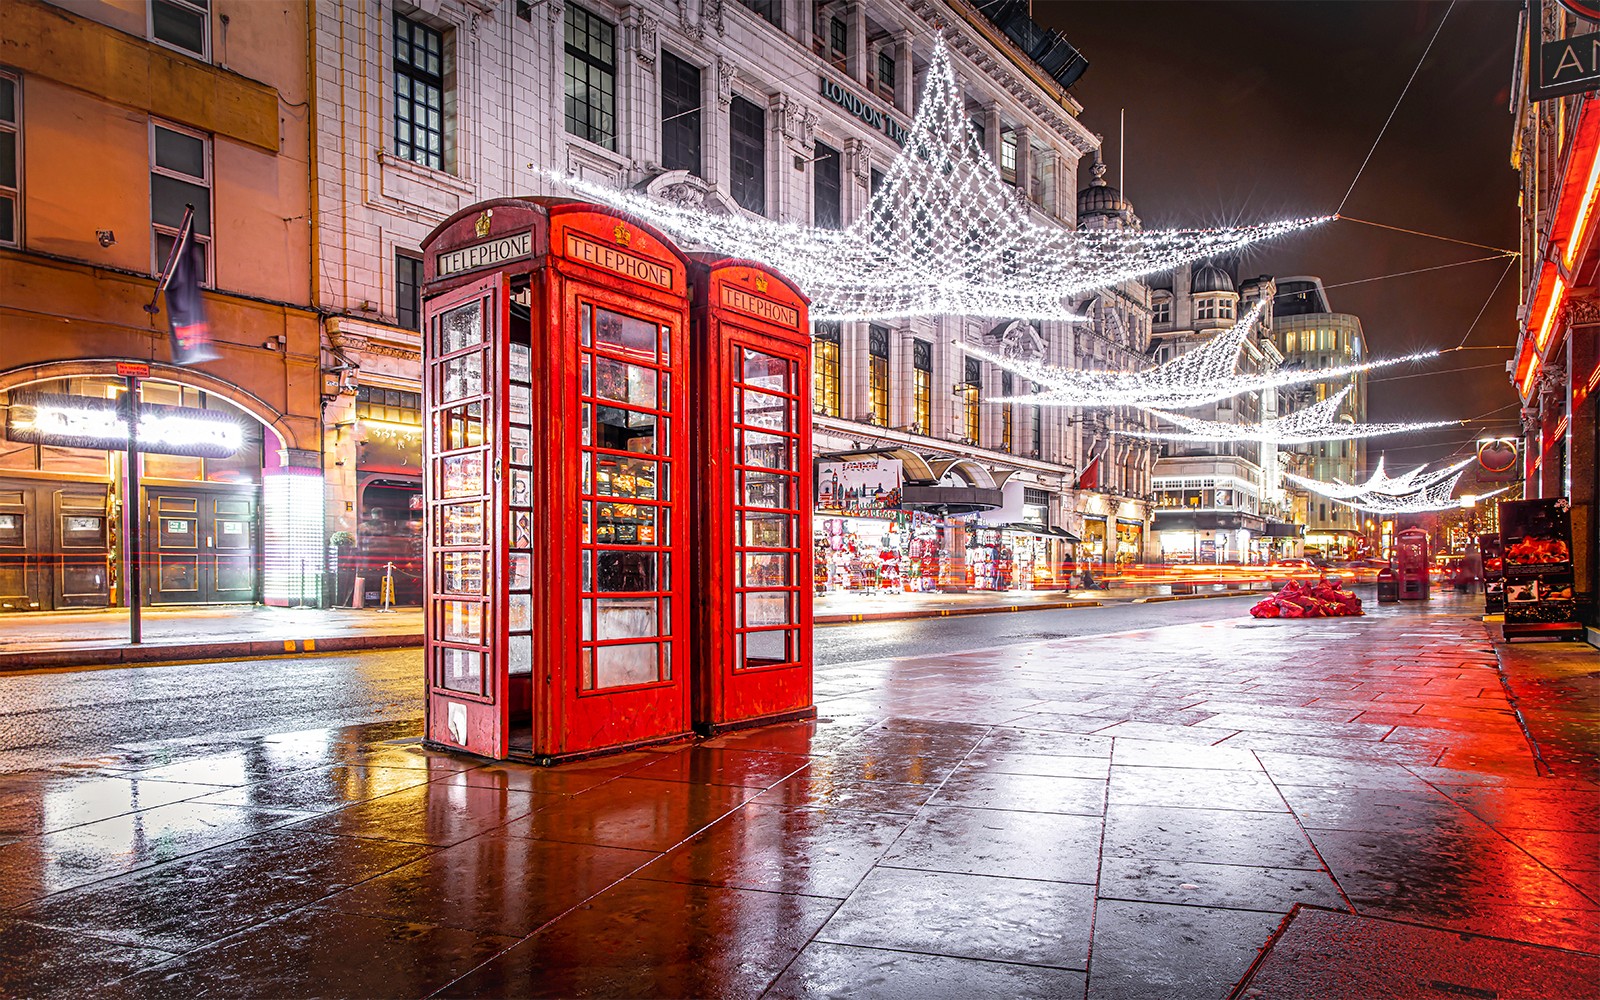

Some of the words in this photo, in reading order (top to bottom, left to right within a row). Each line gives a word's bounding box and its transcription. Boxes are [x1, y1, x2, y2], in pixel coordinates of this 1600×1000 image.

[824, 77, 883, 129] LONDON
[442, 234, 530, 275] TELEPHONE
[570, 237, 668, 287] TELEPHONE
[724, 288, 795, 326] TELEPHONE
